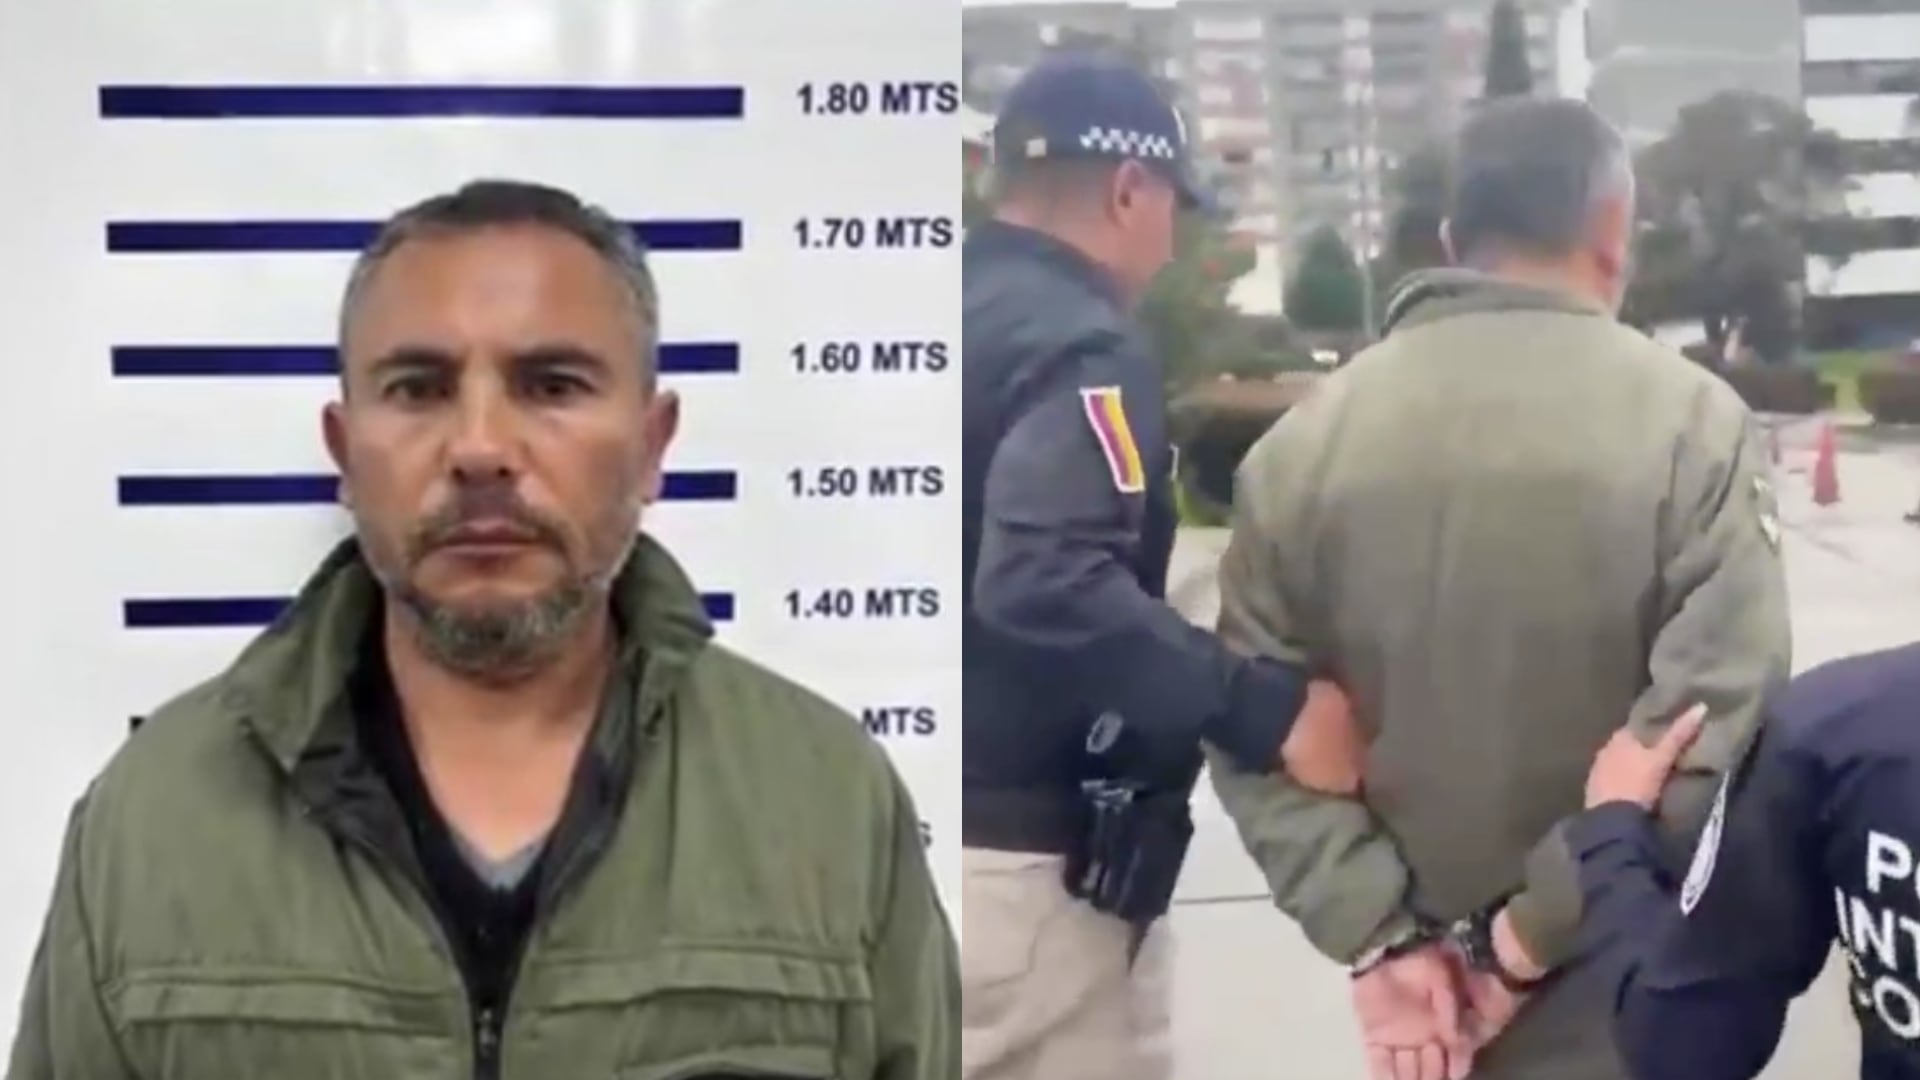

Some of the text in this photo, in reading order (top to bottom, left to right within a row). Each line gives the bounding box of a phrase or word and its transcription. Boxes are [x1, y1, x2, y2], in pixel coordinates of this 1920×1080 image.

[797, 81, 959, 115] 1.80 MTS
[794, 216, 954, 249] 1.70 MTS
[791, 341, 948, 373] 1.60 MTS
[788, 465, 944, 497] 1.50 MTS
[785, 588, 940, 618] 1.40 MTS
[862, 707, 936, 736] MTS
[1866, 830, 1920, 900] P
